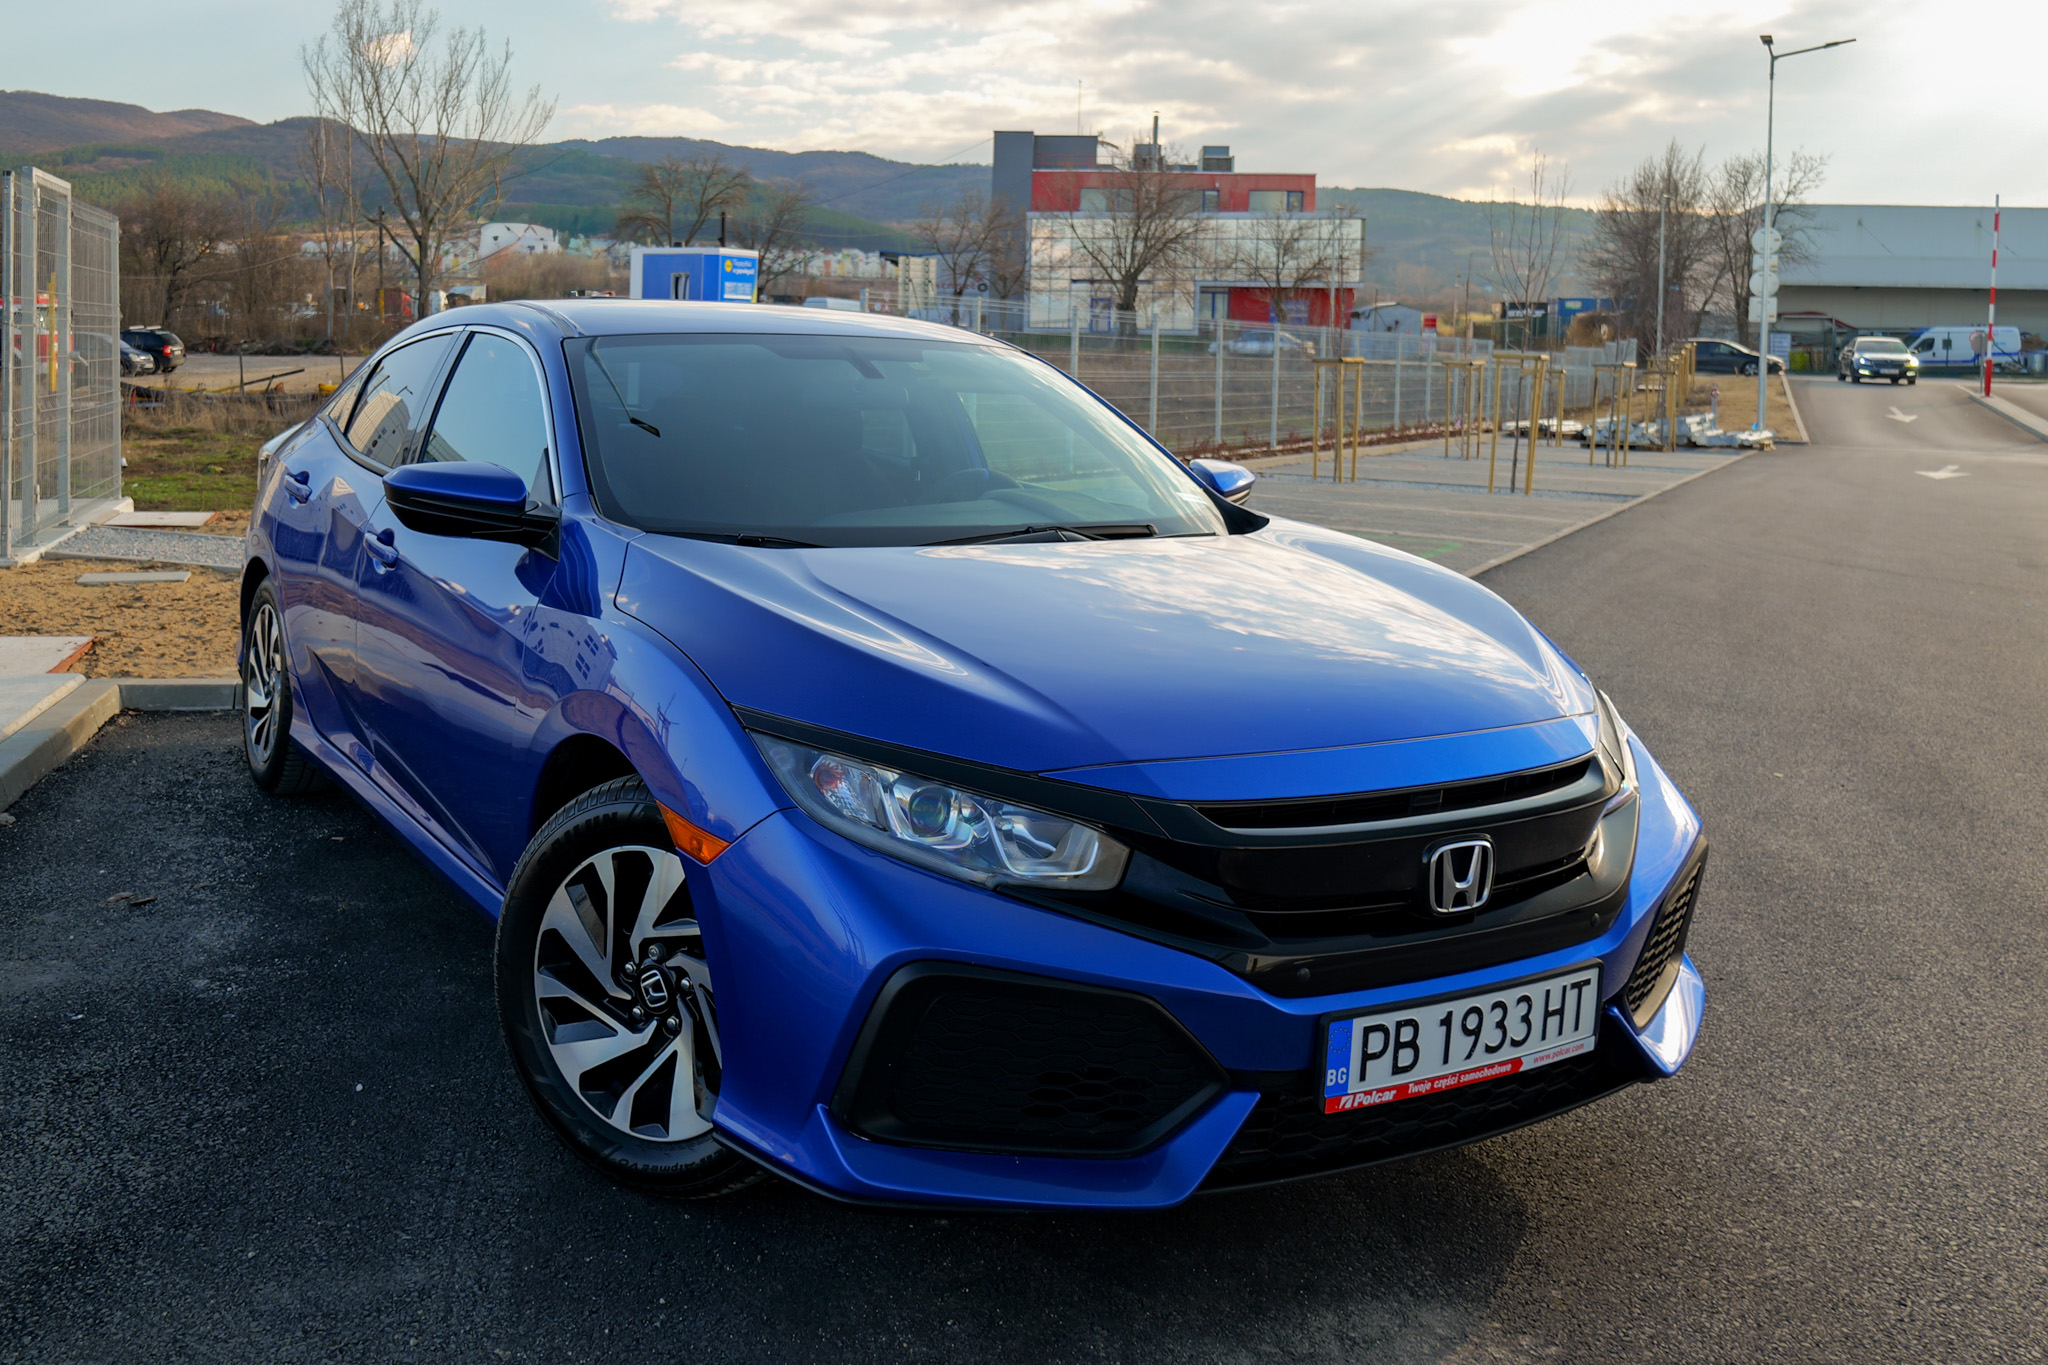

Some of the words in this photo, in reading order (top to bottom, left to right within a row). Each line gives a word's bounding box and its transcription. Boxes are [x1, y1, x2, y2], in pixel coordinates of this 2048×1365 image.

[1359, 1017, 1420, 1082] PB
[1439, 994, 1533, 1066] 1933
[1541, 978, 1592, 1041] HT
[1533, 1042, 1585, 1064] www.polcar.com
[1326, 1067, 1347, 1087] BG
[1408, 1080, 1431, 1094] Twoje
[1434, 1073, 1459, 1089] części
[1460, 1062, 1512, 1083] samochodowe
[1352, 1089, 1397, 1107] Polcar
